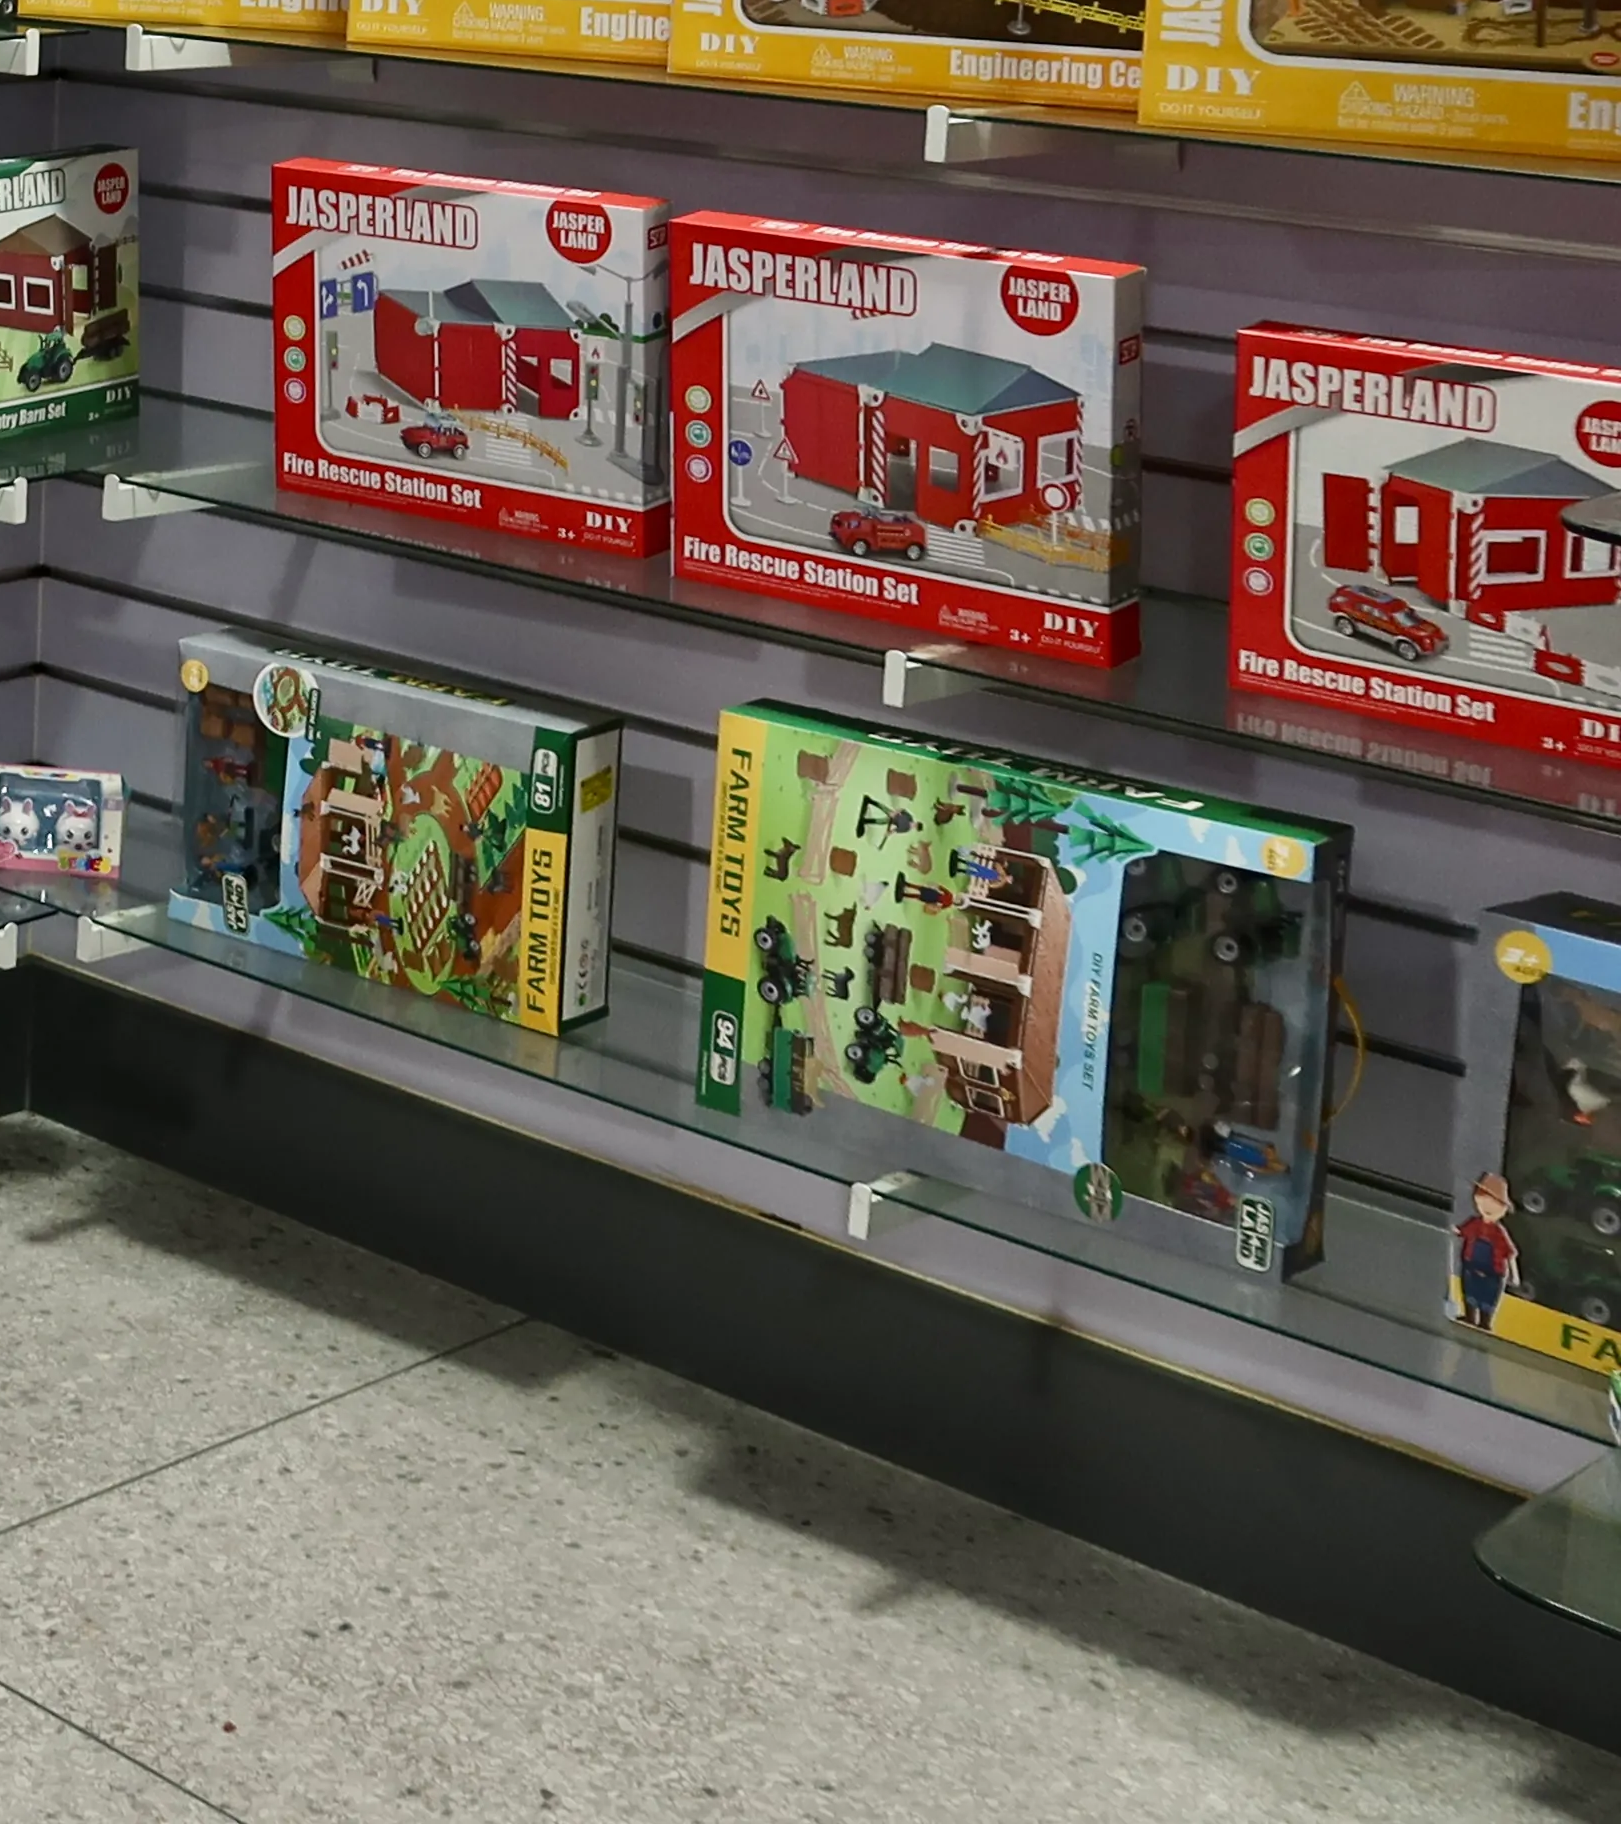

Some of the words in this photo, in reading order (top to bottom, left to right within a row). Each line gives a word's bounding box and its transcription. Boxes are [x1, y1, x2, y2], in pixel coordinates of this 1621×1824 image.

[488, 1, 545, 22] WARNING
[699, 32, 761, 55] DIY
[949, 49, 1105, 91] Engineering
[1393, 83, 1476, 108] WARNING
[96, 178, 127, 194] JASPER
[100, 188, 123, 206] LAND
[285, 184, 477, 250] JASPERLAND
[552, 210, 605, 232] JASPER
[559, 229, 599, 252] LAND
[688, 242, 918, 317] JASPERLAND
[1007, 276, 1072, 305] JASPER
[1016, 297, 1064, 323] LAND
[1249, 355, 1496, 433] JASPERLAND
[15, 407, 43, 428] Barn
[44, 401, 67, 423] Set
[283, 451, 315, 477] Fire
[317, 458, 382, 489] Rescue
[383, 471, 449, 503] Station
[450, 485, 482, 509] Set
[682, 536, 721, 565] Fire
[723, 544, 801, 581] Rescue
[803, 560, 881, 596] Station
[882, 576, 920, 606] Set
[1043, 611, 1101, 639] DIY
[1238, 648, 1281, 678] Fire
[1282, 656, 1366, 696] Rescue
[1369, 675, 1453, 716] Station
[1455, 694, 1498, 724] Set
[539, 752, 550, 776] PCS
[535, 783, 553, 810] 81
[732, 745, 754, 841] FARM
[529, 846, 554, 926] TOYS
[719, 848, 747, 940] TOYS
[524, 930, 549, 1016] FARM
[1090, 951, 1103, 981] DIY
[1086, 982, 1100, 1024] FARM
[715, 1012, 736, 1051] 94
[1083, 1025, 1098, 1062] TOYS
[710, 1052, 730, 1083] PCS
[1080, 1062, 1094, 1092] SET
